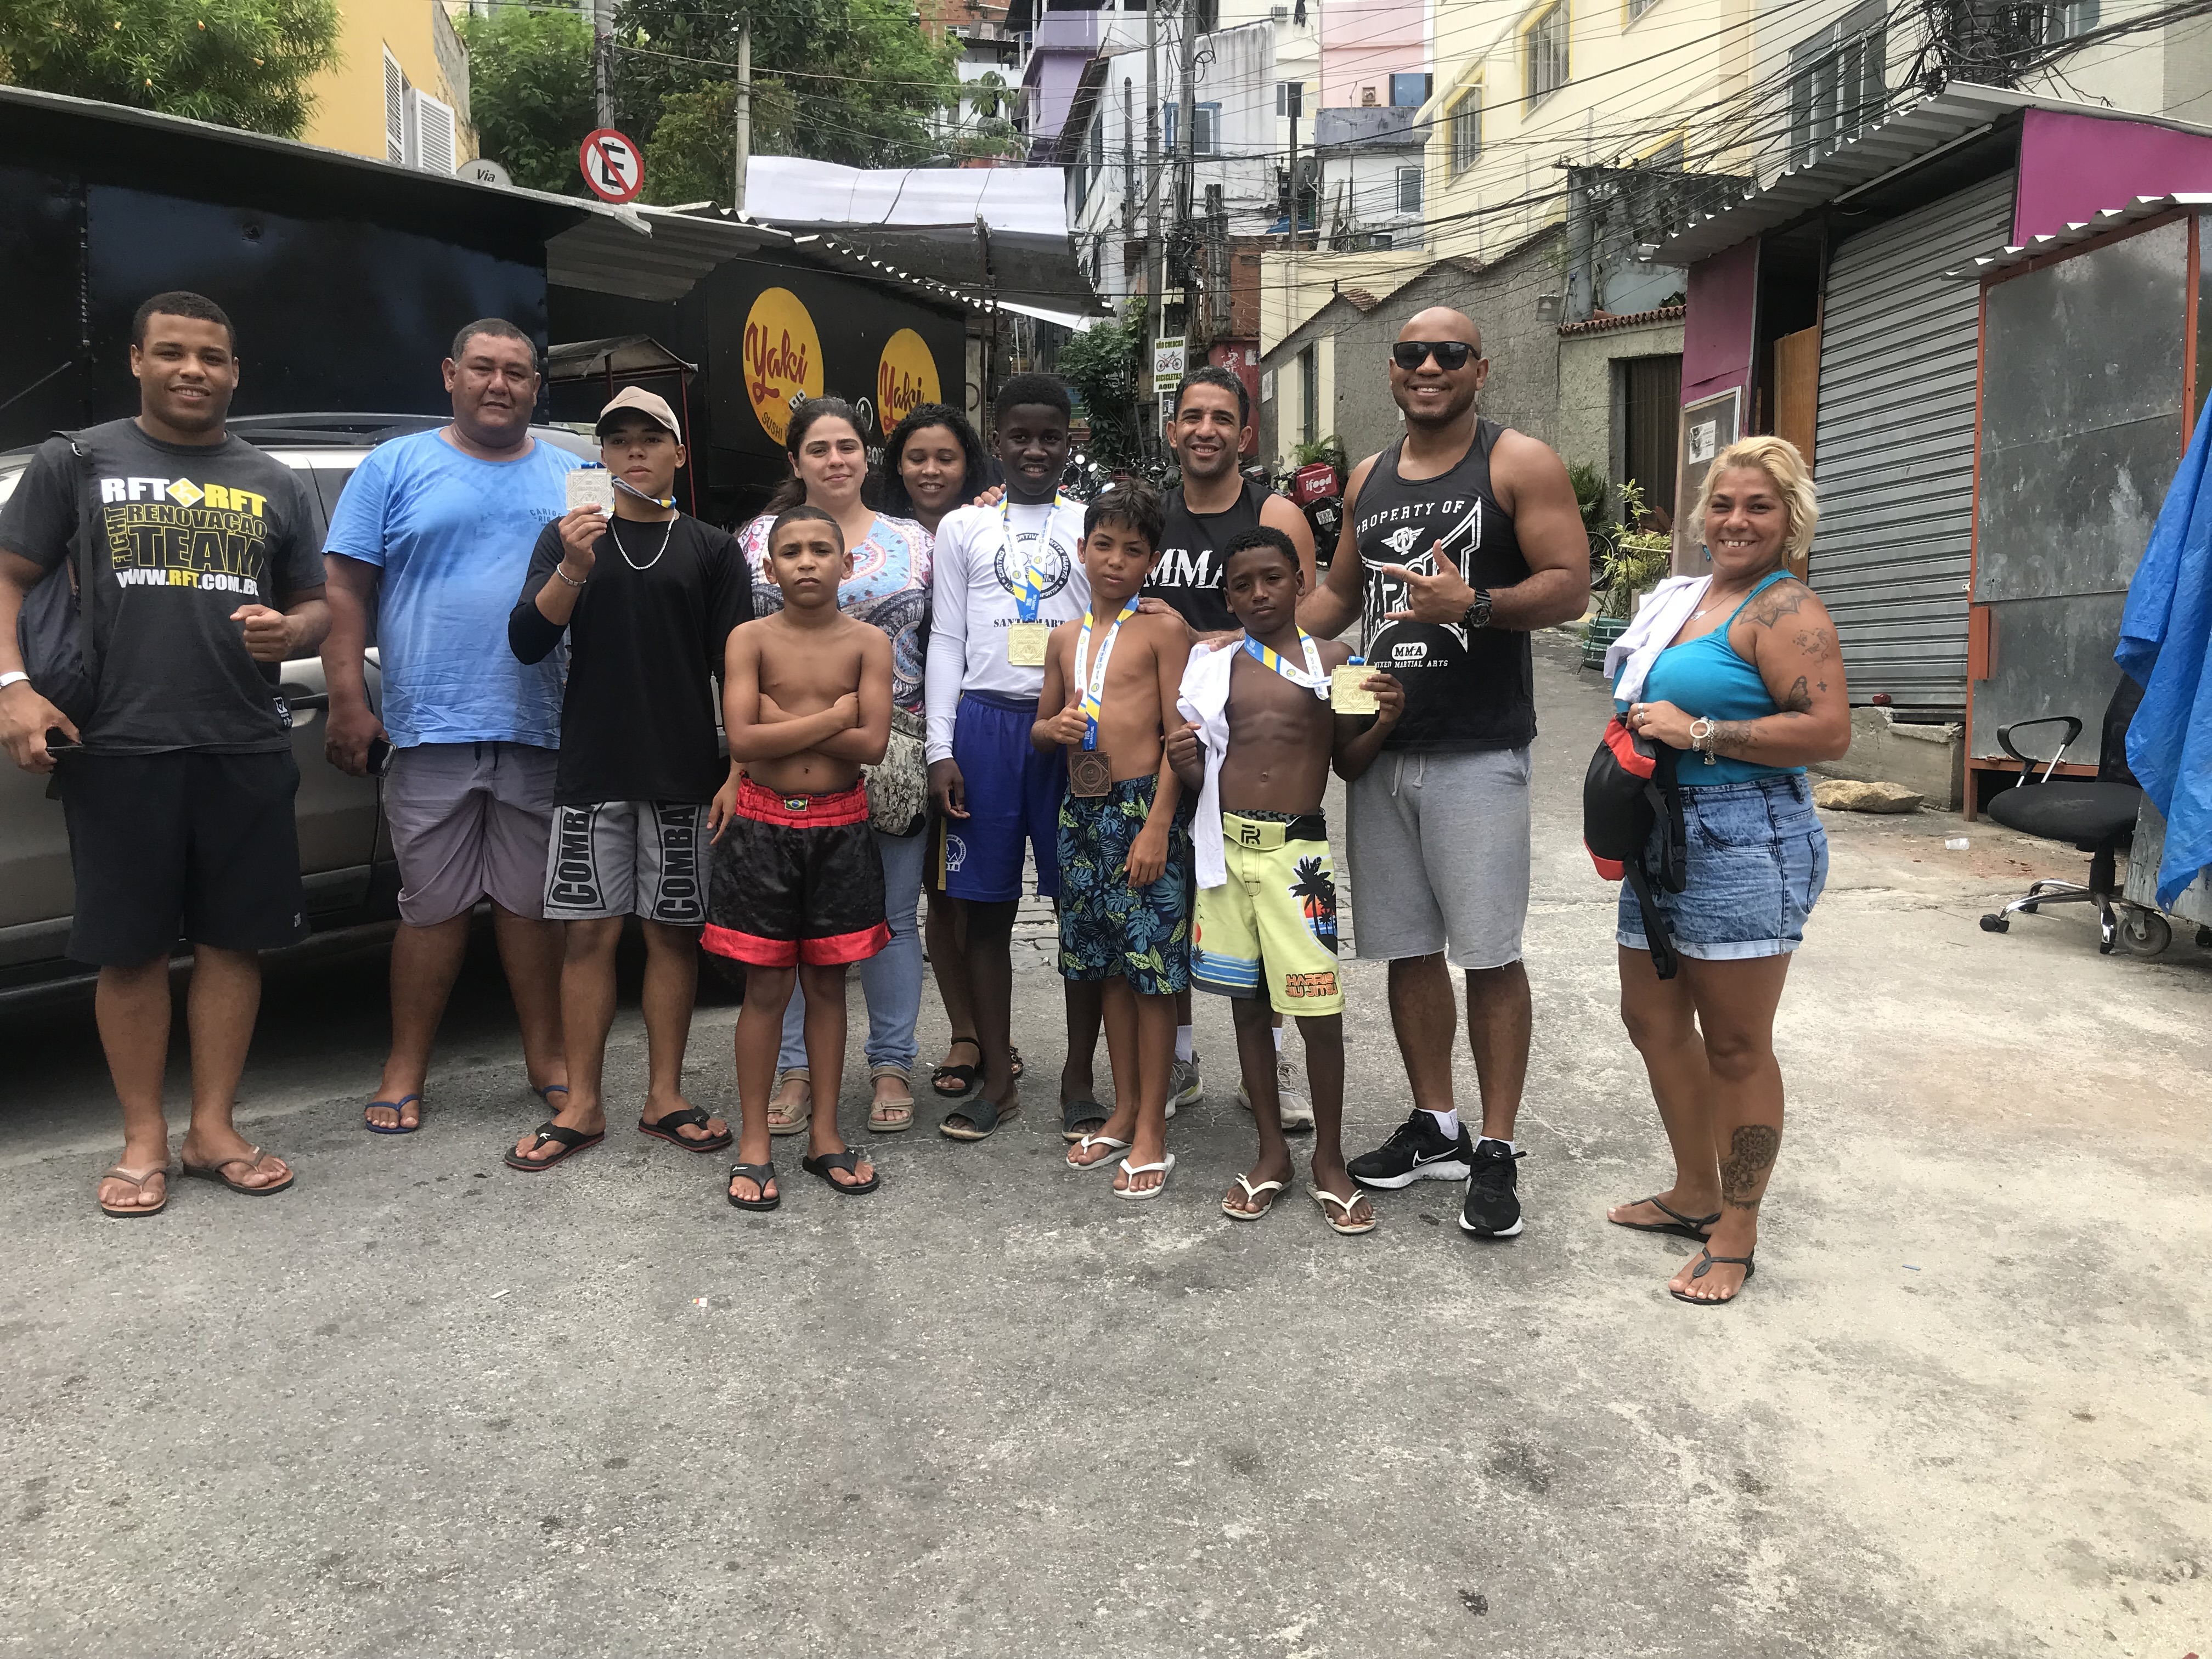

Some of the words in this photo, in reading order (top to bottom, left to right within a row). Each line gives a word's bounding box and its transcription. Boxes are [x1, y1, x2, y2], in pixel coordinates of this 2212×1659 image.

[477, 168, 496, 182] Via
[602, 143, 625, 188] E
[1156, 340, 1164, 349] NÃO
[1165, 340, 1183, 348] COLOCAR
[745, 321, 808, 405] Yaki
[1155, 373, 1182, 382] BICICLETAS
[761, 411, 783, 441] SUSHI
[100, 477, 170, 503] RFT
[1306, 474, 1332, 492] ifood
[204, 483, 267, 517] RFT
[126, 504, 267, 540] RENOVAÇÃO
[1356, 503, 1435, 538] PROPERTY
[1442, 501, 1464, 514] OF
[103, 506, 133, 569] FIGHT
[128, 525, 266, 579] TEAM
[1394, 646, 1423, 657] MMA
[656, 804, 701, 919] COMBA
[1285, 971, 1335, 986] HARRIS
[1285, 985, 1305, 997] JIU
